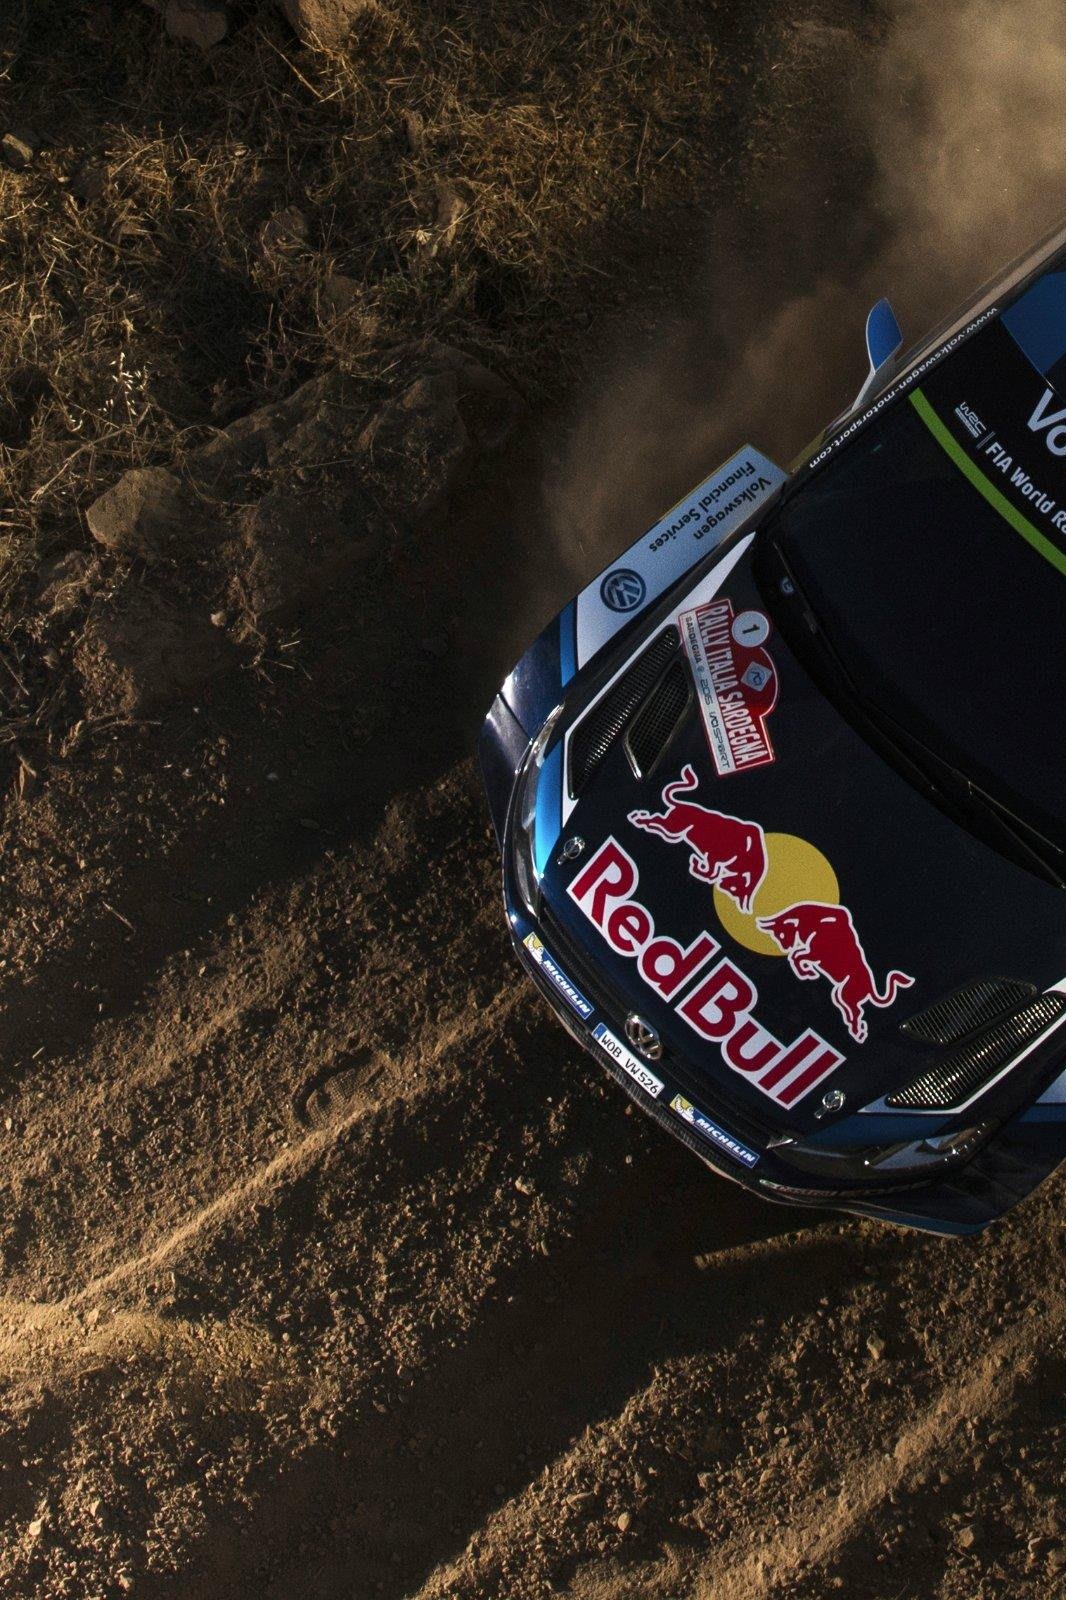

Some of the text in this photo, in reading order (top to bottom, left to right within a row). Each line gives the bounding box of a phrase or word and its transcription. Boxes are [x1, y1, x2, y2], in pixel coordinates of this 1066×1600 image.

[809, 307, 998, 470] www.volkswagen-motorsport.com
[648, 460, 756, 553] Financial Services
[693, 475, 772, 540] Volkswagen
[984, 441, 1013, 474] FIA
[1010, 466, 1056, 515] World
[684, 614, 702, 664] SARDEGNA
[741, 623, 761, 636] 1
[697, 604, 769, 766] RALLY ITALIA SARDEGNA
[542, 959, 591, 1014] MICHELIN
[568, 837, 845, 1109] Red Bull
[600, 1033, 623, 1059] WOB
[695, 1118, 757, 1163] MICHELIN
